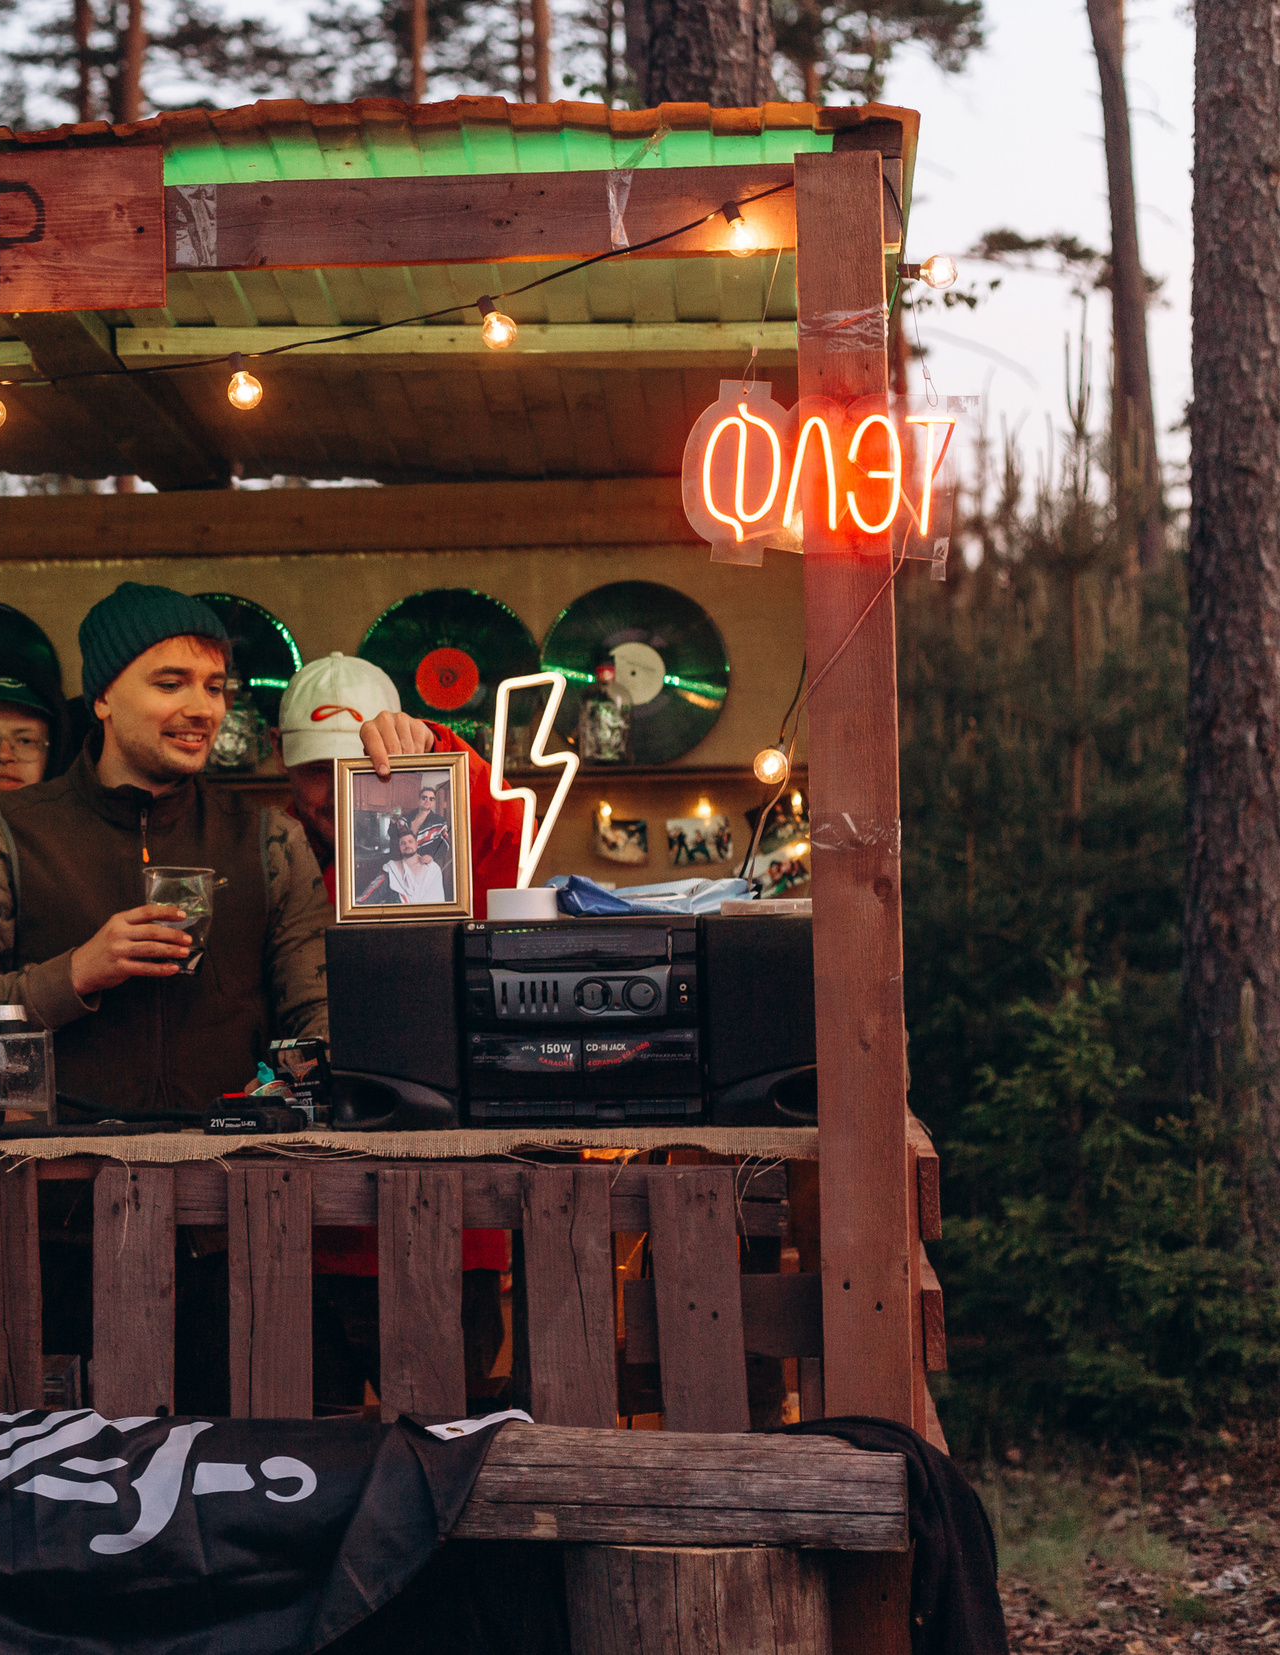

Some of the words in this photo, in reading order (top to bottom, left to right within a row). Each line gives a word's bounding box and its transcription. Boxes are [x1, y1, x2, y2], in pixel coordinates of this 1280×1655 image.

[702, 402, 957, 544] ФЛЭТ
[540, 1043, 571, 1054] 150W
[210, 1118, 226, 1128] 21V
